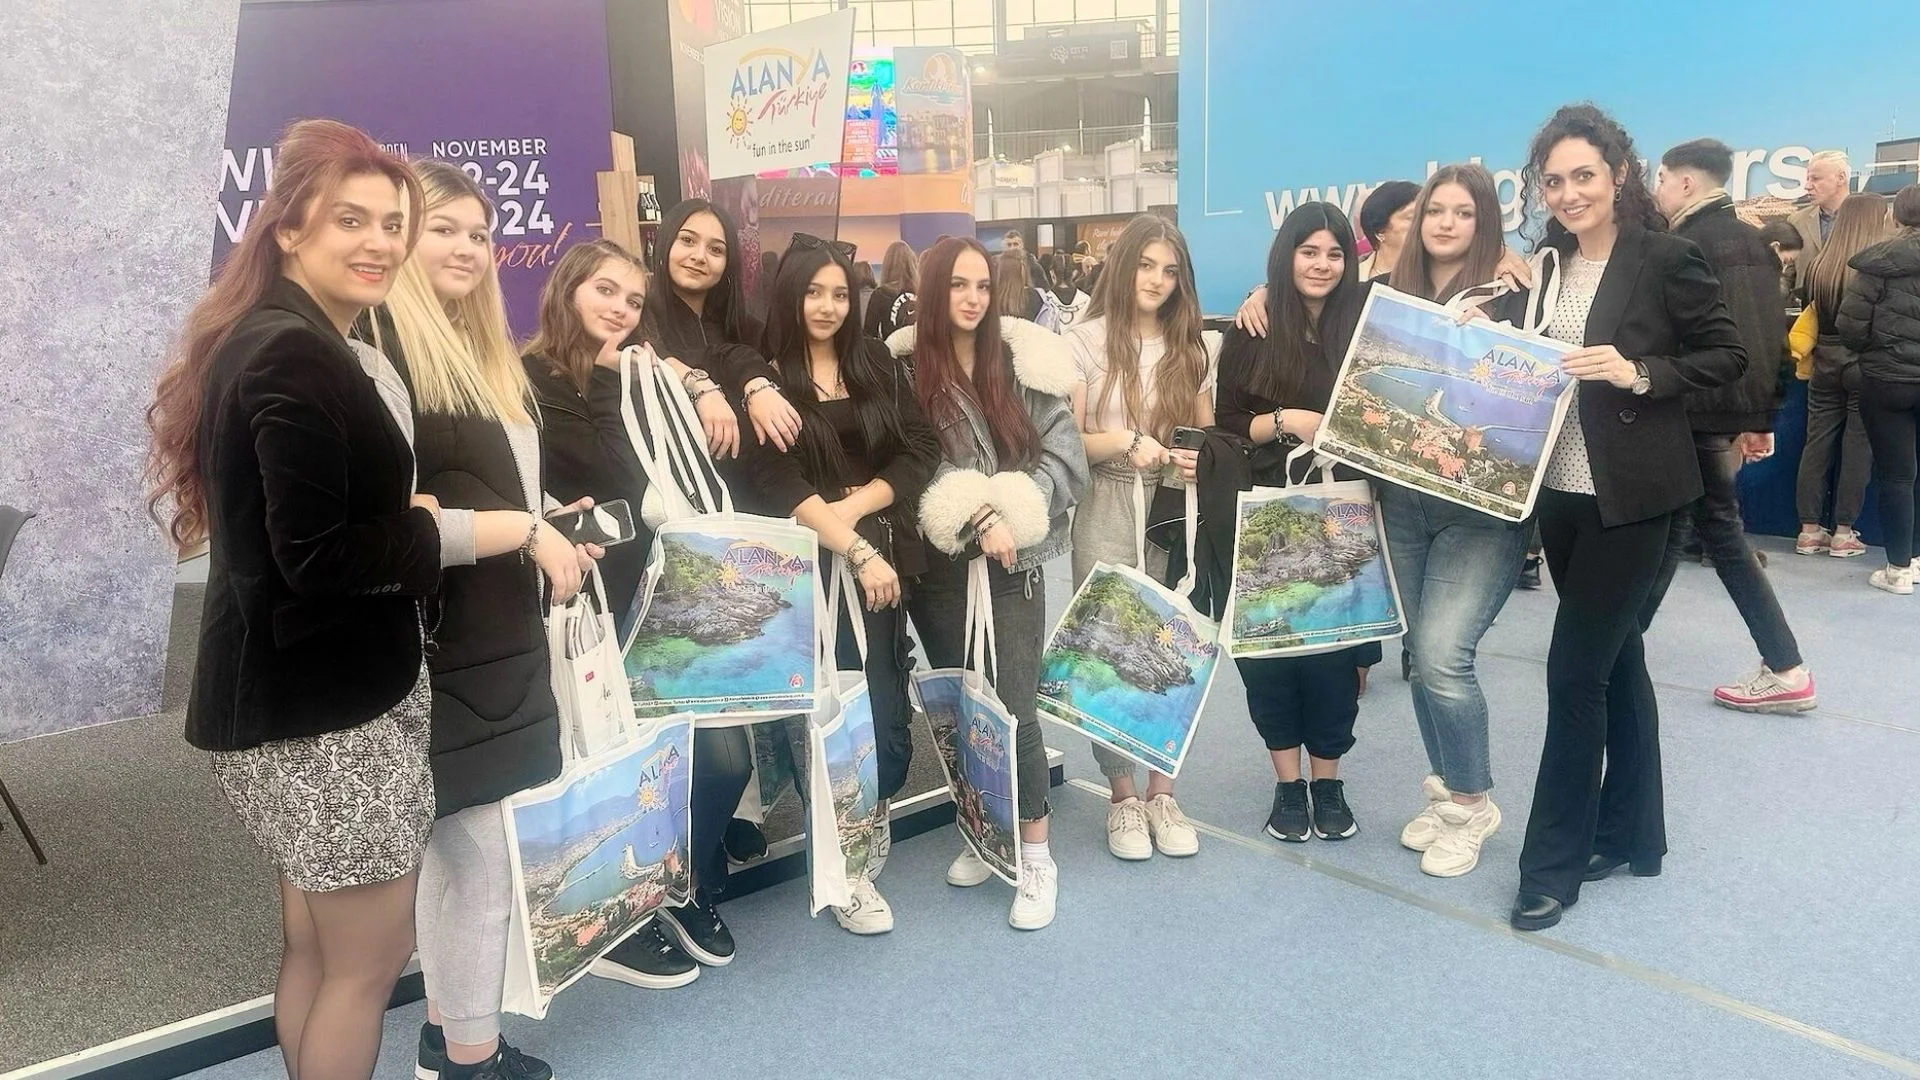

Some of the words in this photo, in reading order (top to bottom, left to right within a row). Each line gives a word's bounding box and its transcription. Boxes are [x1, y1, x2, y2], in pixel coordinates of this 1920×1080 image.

[730, 47, 831, 99] ALANYA
[432, 138, 547, 158] NOVEMBER
[768, 142, 777, 156] in
[778, 138, 793, 154] the
